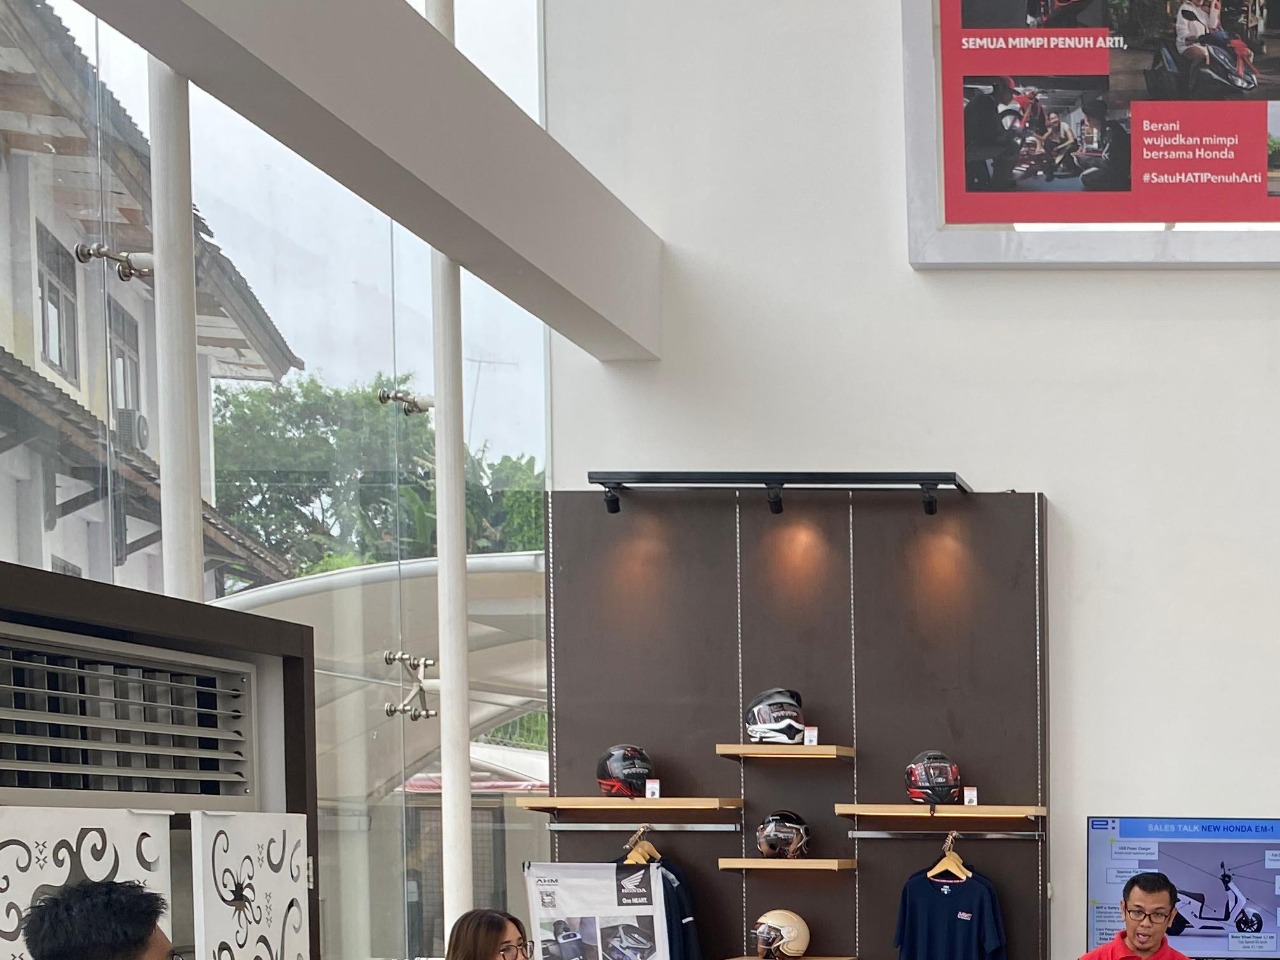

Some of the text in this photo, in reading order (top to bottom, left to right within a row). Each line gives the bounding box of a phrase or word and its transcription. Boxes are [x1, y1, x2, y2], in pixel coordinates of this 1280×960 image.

[961, 36, 1128, 50] SEMUA MIMPI PENUH ARTI,
[1143, 120, 1180, 131] Berani
[1143, 134, 1238, 147] wujudkan mimpi
[1143, 148, 1235, 159] bersama Honda
[1142, 172, 1261, 183] #SatuHATIPenuhArti
[1148, 824, 1175, 832] SALES
[1177, 824, 1199, 832] TALK
[1223, 825, 1253, 833] HONDA
[1255, 825, 1274, 833] EM-1
